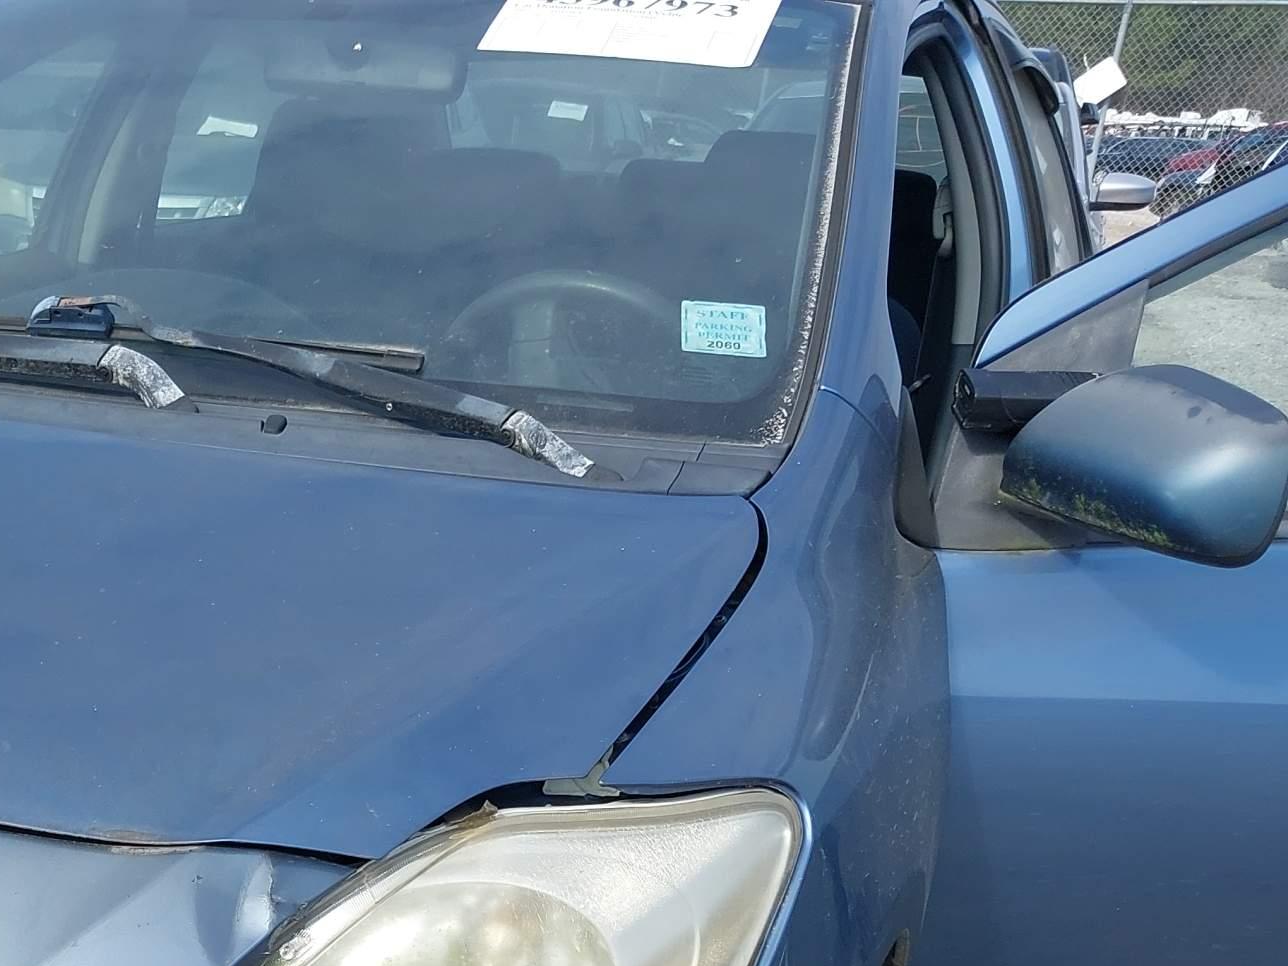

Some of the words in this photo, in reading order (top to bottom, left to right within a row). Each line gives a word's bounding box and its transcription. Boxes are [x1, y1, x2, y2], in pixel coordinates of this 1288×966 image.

[546, 0, 741, 18] 67973
[695, 322, 752, 333] PARKING
[697, 331, 750, 342] PERMIT
